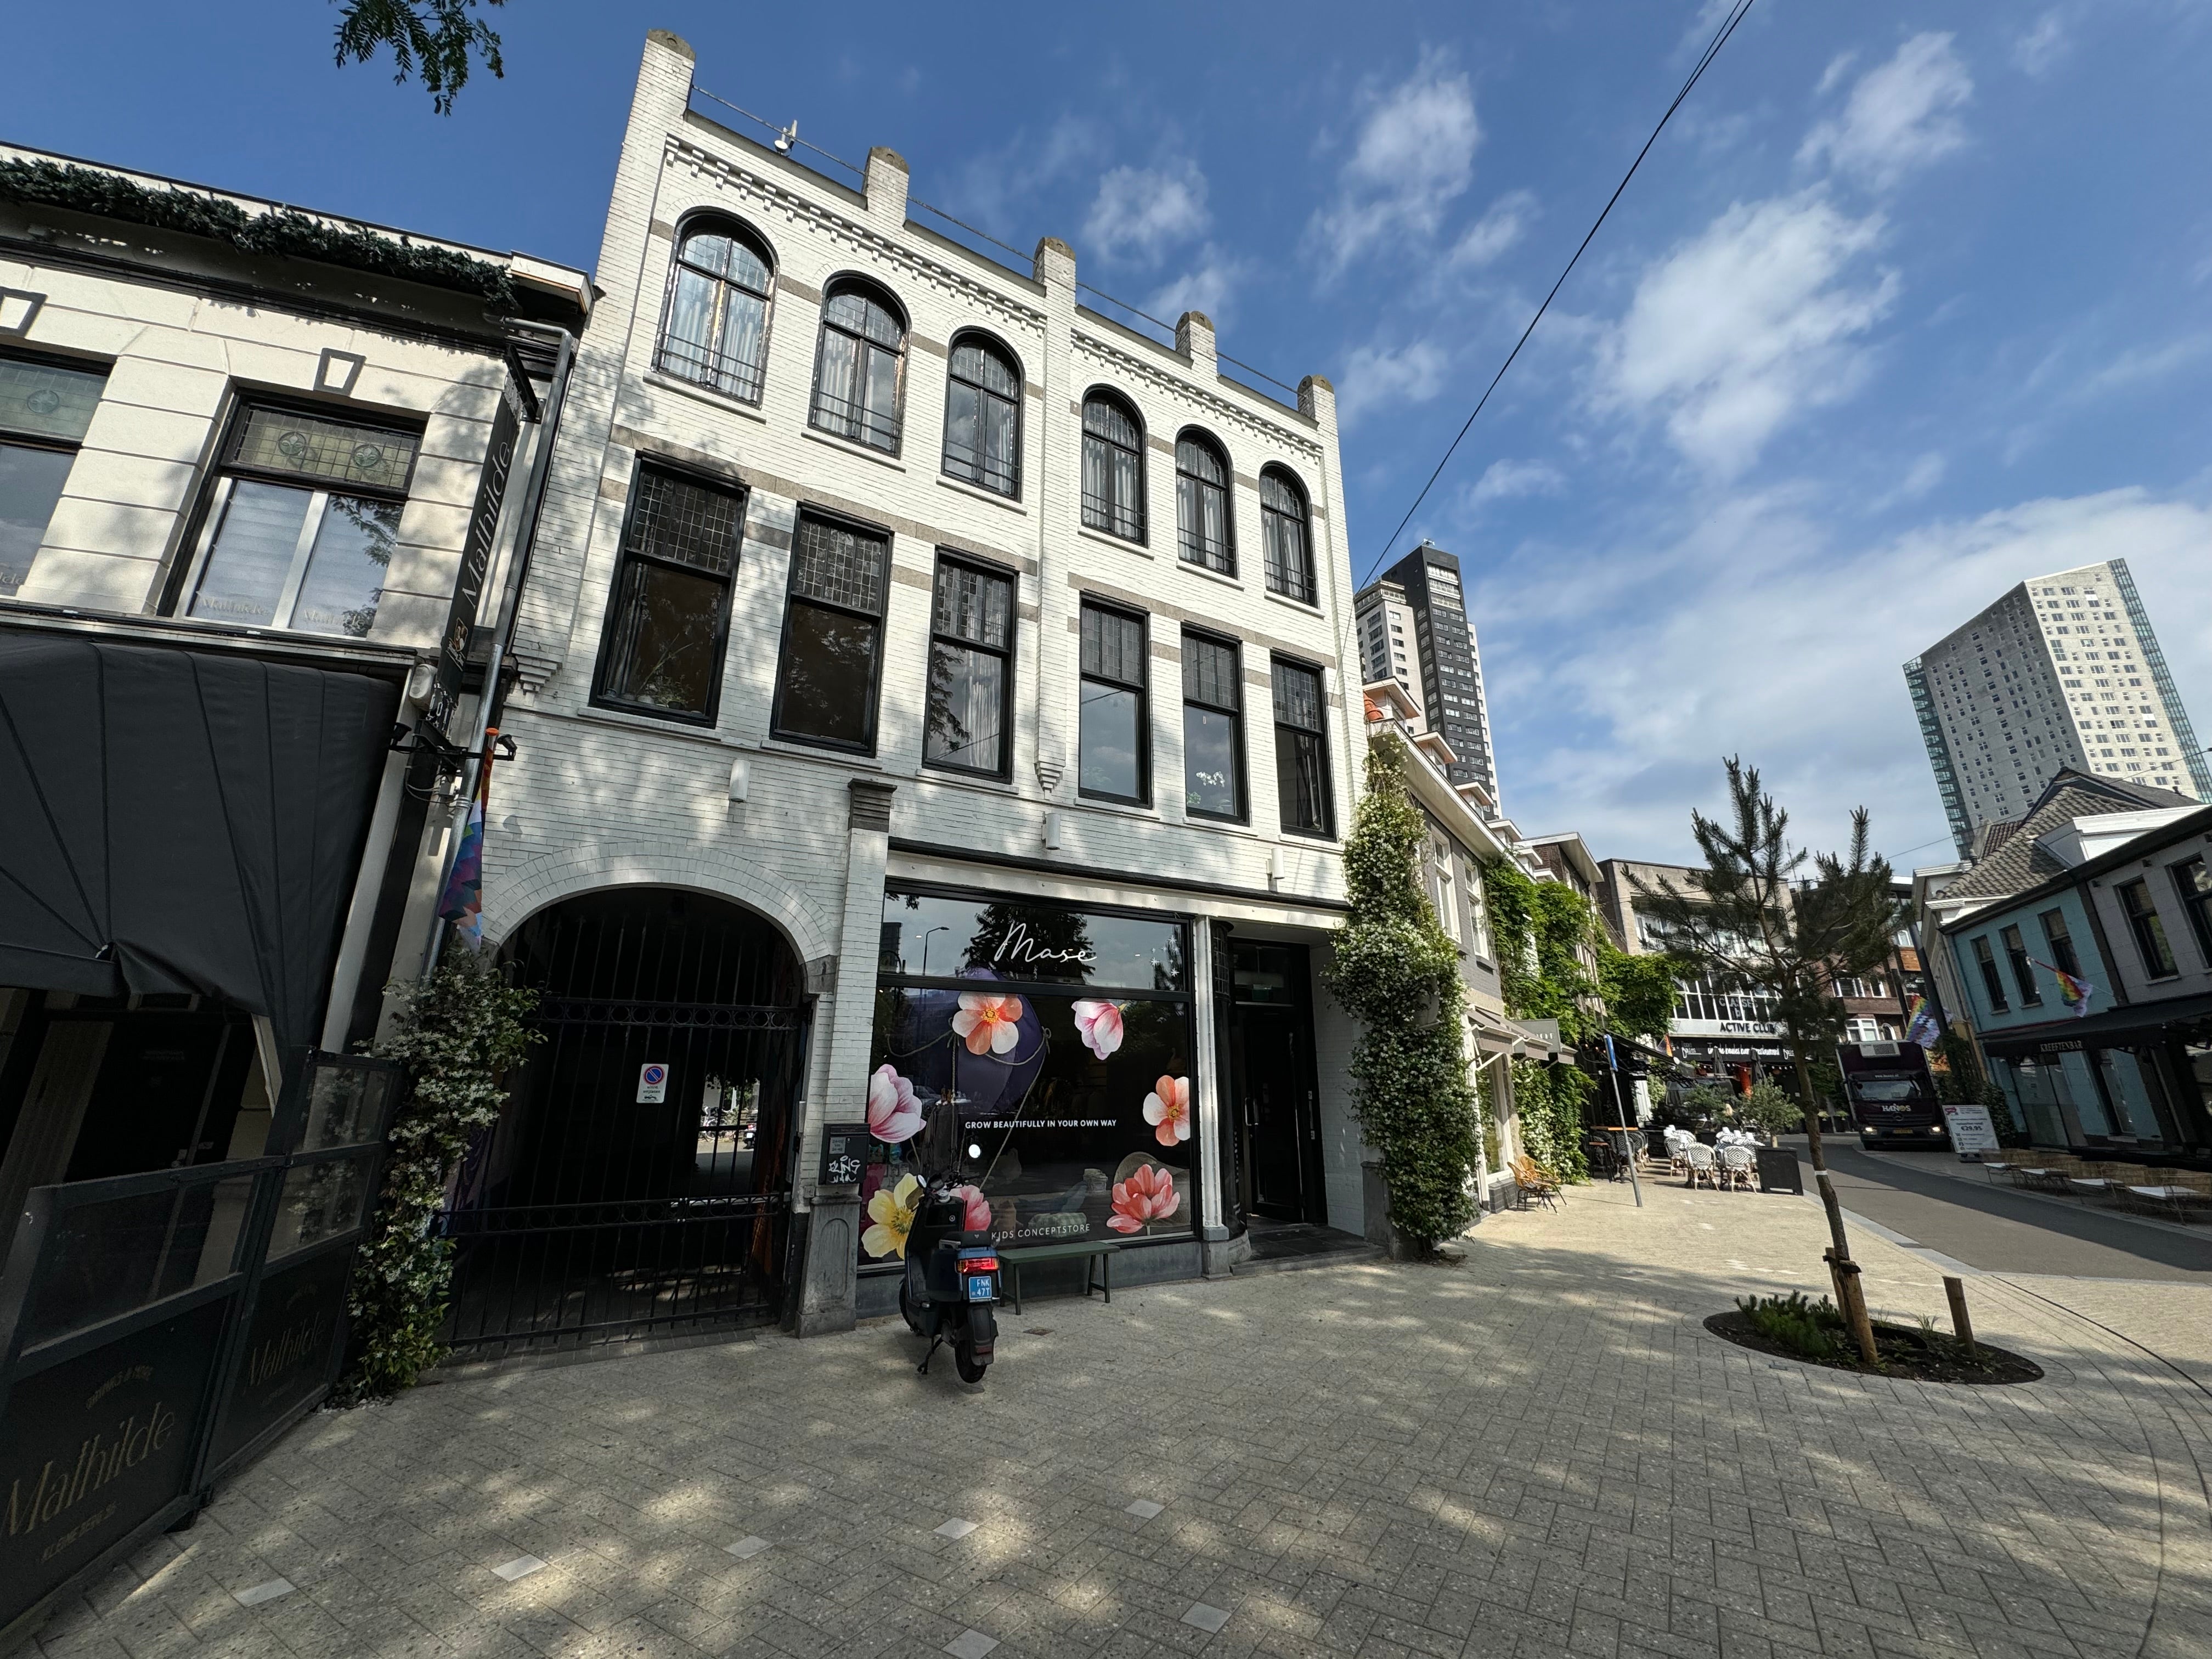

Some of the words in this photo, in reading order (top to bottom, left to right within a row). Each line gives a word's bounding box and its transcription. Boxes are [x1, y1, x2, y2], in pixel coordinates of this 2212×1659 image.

[461, 441, 510, 610] Mathilde
[994, 922, 1097, 962] Mase
[1720, 1022, 1751, 1033] ACTIVE
[2040, 1040, 2083, 1052] KREEFTENBAR
[1882, 1104, 1911, 1112] HANOS
[965, 1121, 991, 1129] GROW
[993, 1120, 1045, 1128] BEAUTIFULLY
[991, 1231, 1014, 1241] KIDS
[1018, 1223, 1091, 1238] CONCEPTSTORE
[977, 1278, 990, 1287] FNK
[977, 1288, 990, 1296] 47T
[4, 1401, 175, 1537] Mathilde
